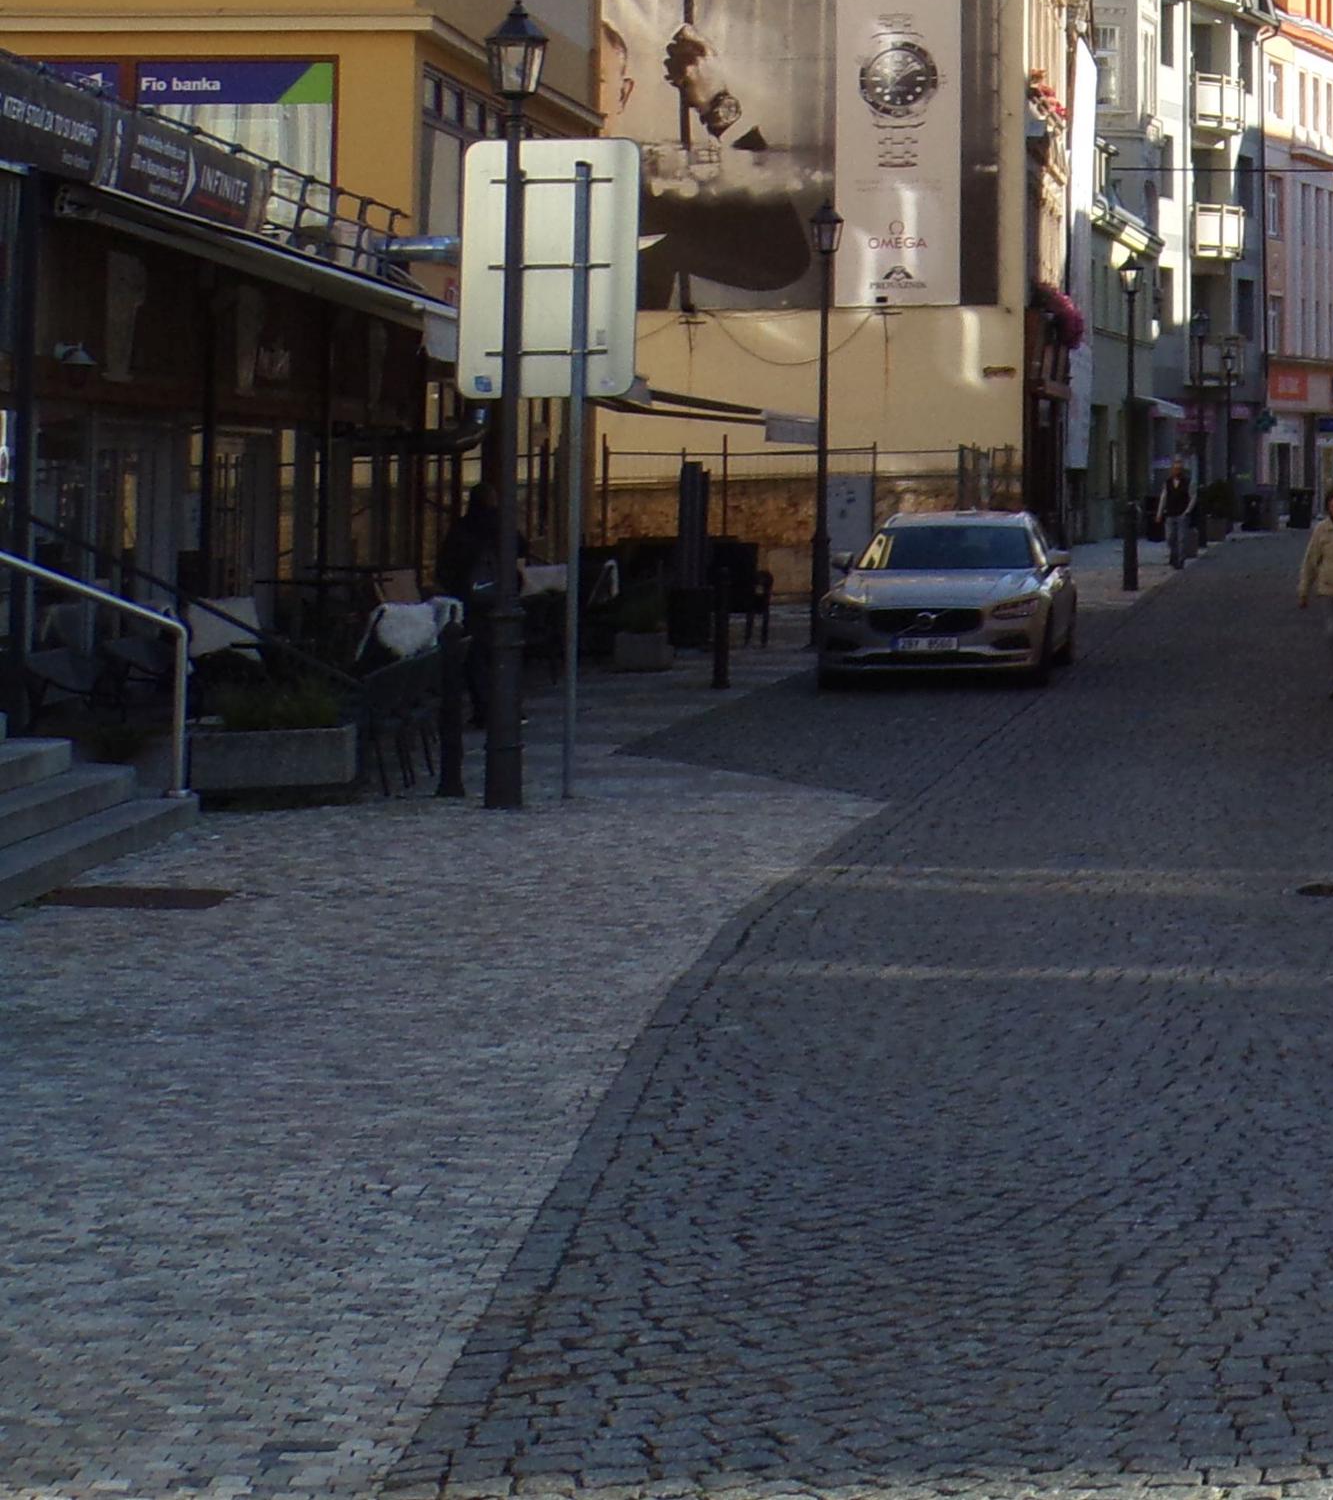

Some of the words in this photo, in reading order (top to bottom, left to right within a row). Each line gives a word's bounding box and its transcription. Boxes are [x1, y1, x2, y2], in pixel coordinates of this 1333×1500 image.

[140, 77, 167, 92] Fio
[172, 77, 221, 92] banka
[868, 237, 928, 250] OMEGA
